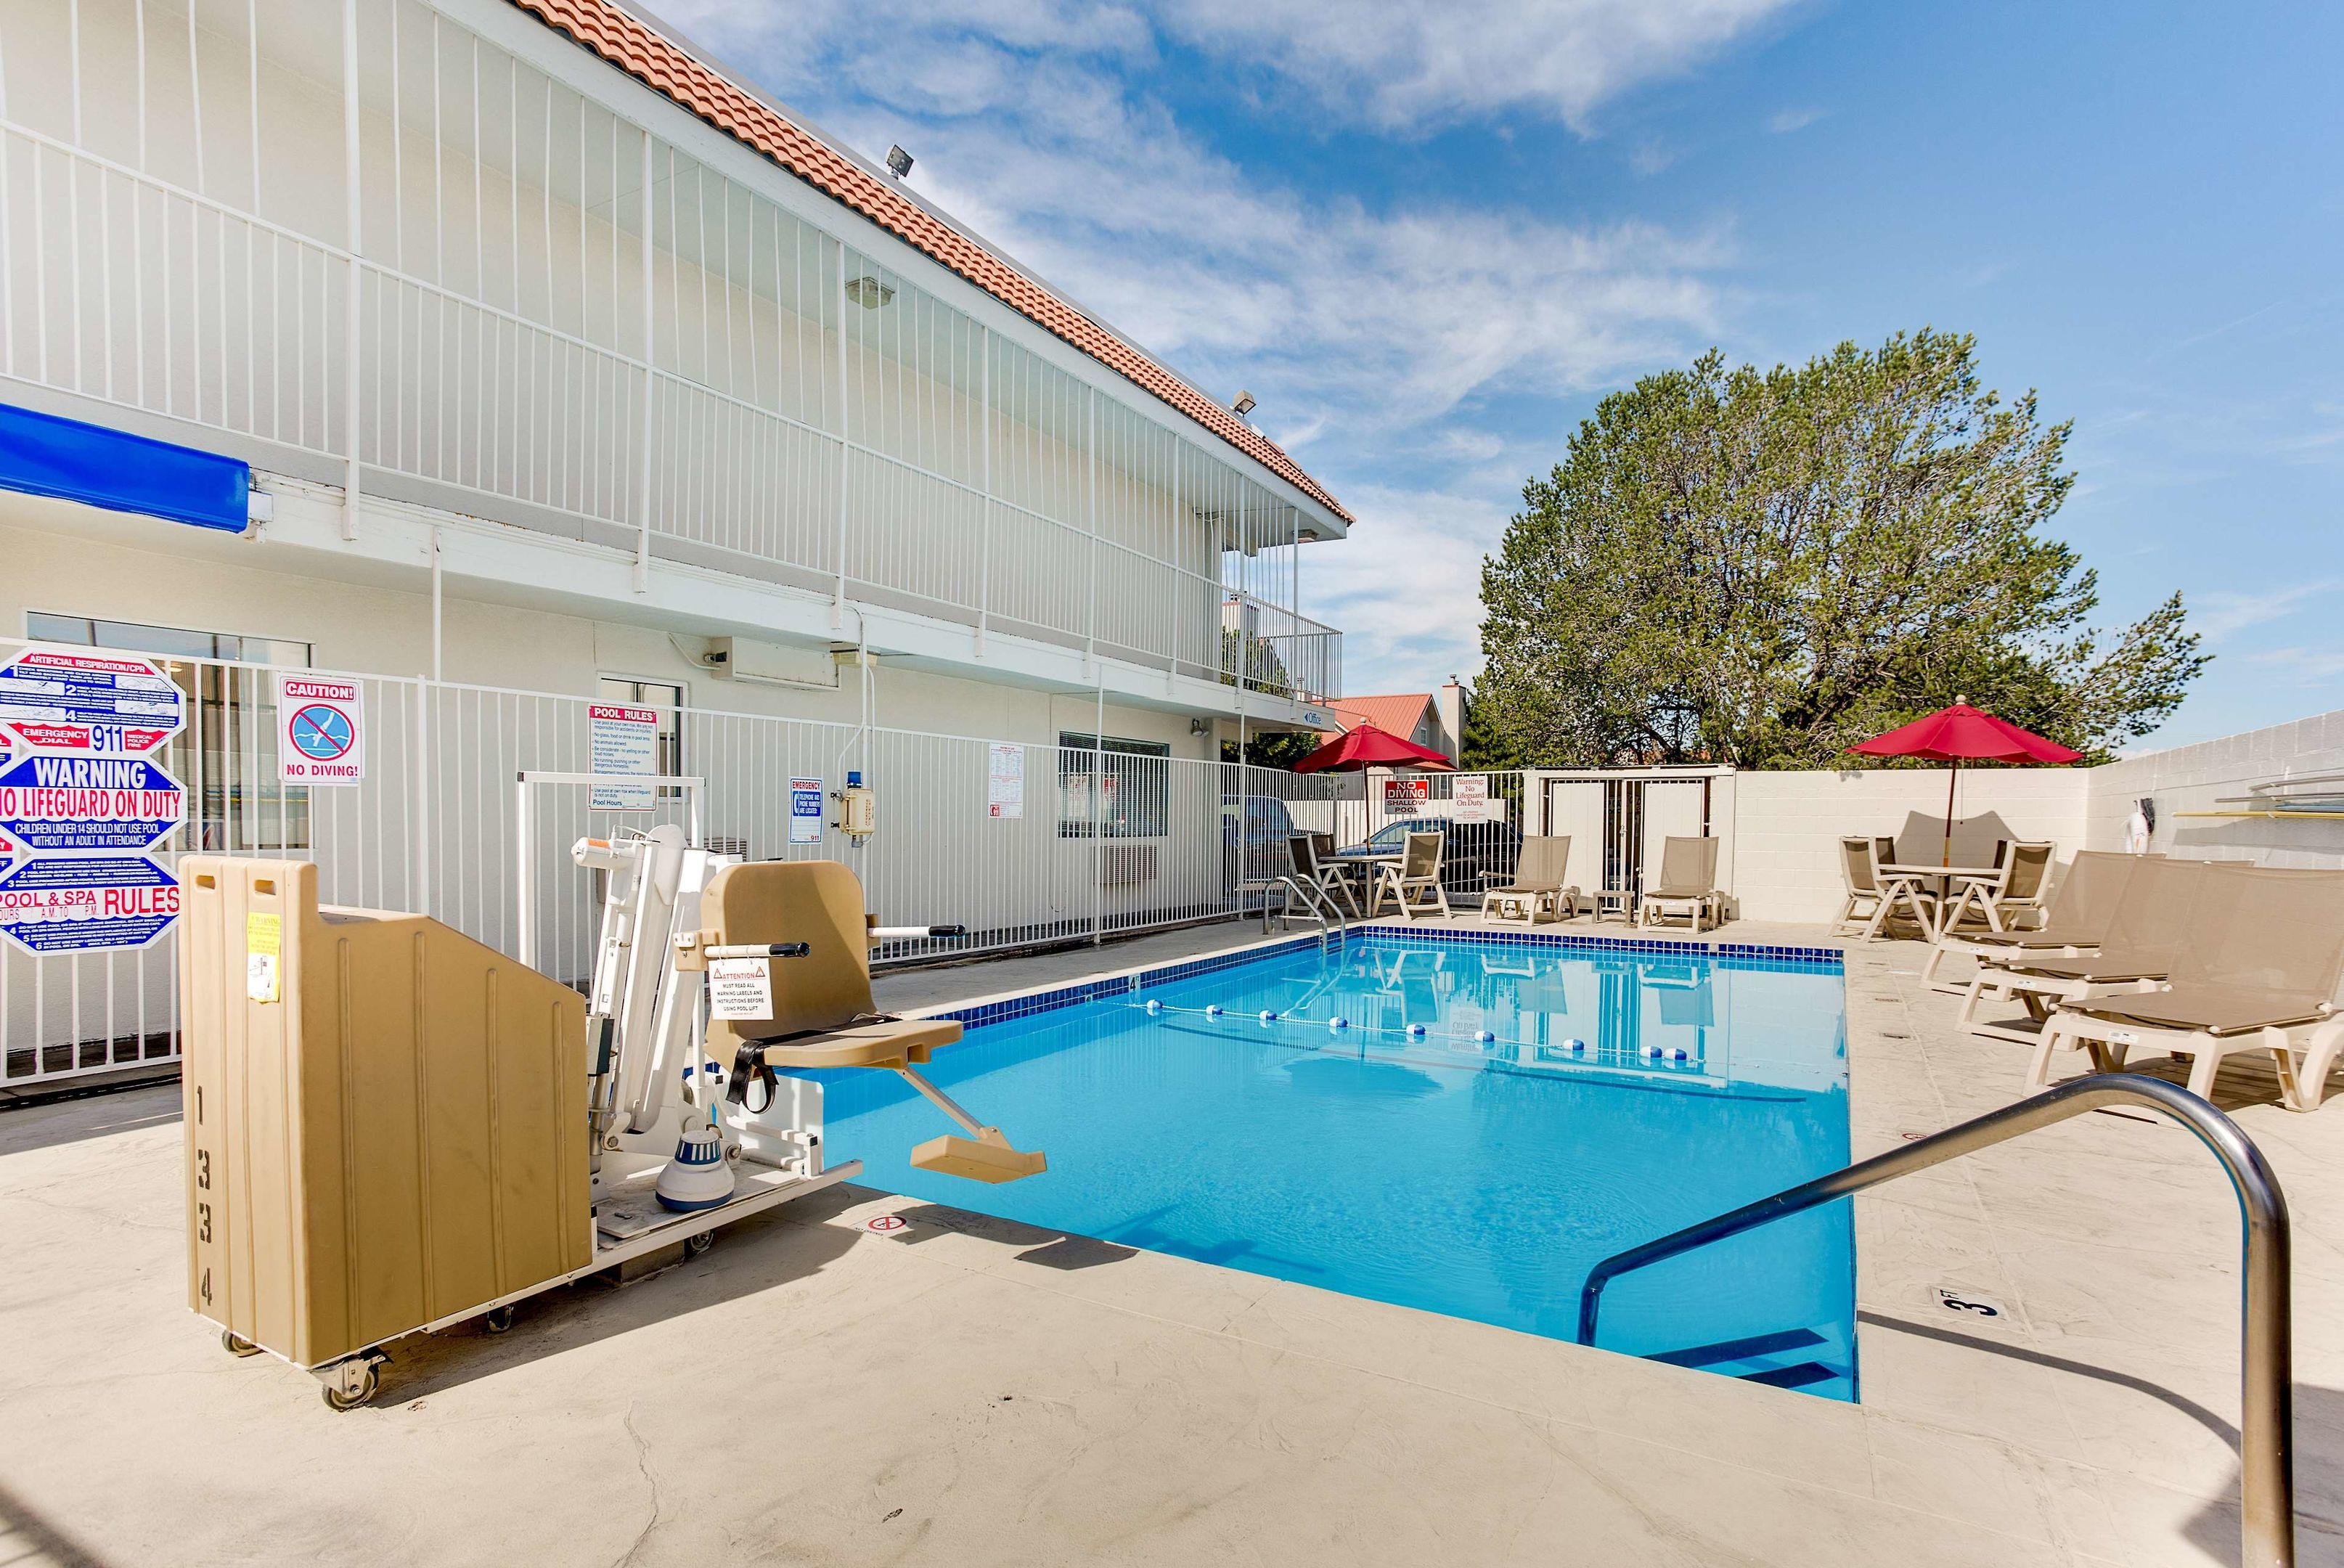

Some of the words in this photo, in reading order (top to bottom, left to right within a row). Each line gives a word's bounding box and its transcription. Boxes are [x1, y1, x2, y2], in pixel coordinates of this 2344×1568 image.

[30, 656, 74, 666] ARTIFICIAL
[75, 659, 145, 673] RESPIRATION/CPR
[9, 666, 18, 677] 1
[65, 685, 76, 696] 2
[287, 682, 354, 699] CAUTION!
[66, 710, 77, 721] 4
[595, 708, 621, 718] POOL
[624, 711, 653, 722] RULES
[23, 728, 88, 738] EMERGENCY
[93, 725, 122, 751] 911
[33, 758, 146, 789] WARNING
[287, 764, 305, 775] NO
[311, 765, 358, 776] DIVING!
[793, 781, 820, 790] EMERGENCY
[1388, 789, 1425, 798] DIVING
[0, 788, 16, 817] O
[23, 788, 109, 817] LIFEGUARD
[115, 791, 136, 817] ON
[144, 791, 181, 817] DUTY
[15, 823, 52, 834] CHILDREN
[52, 823, 76, 833] UNDER
[78, 823, 86, 833] 14
[86, 823, 113, 833] SHOULD
[114, 823, 128, 833] NOT
[128, 823, 142, 833] USE
[142, 823, 160, 833] POOL
[32, 836, 63, 846] WITHOUT
[65, 836, 74, 846] AN
[75, 836, 96, 846] ADULT
[97, 836, 105, 845] IN
[106, 836, 146, 845] ATTENDANCE
[49, 892, 59, 906] &
[65, 891, 97, 905] SPA
[105, 886, 179, 915] RULES
[0, 909, 20, 920] OURS
[60, 907, 68, 917] TO
[1943, 1299, 1998, 1316] 3
